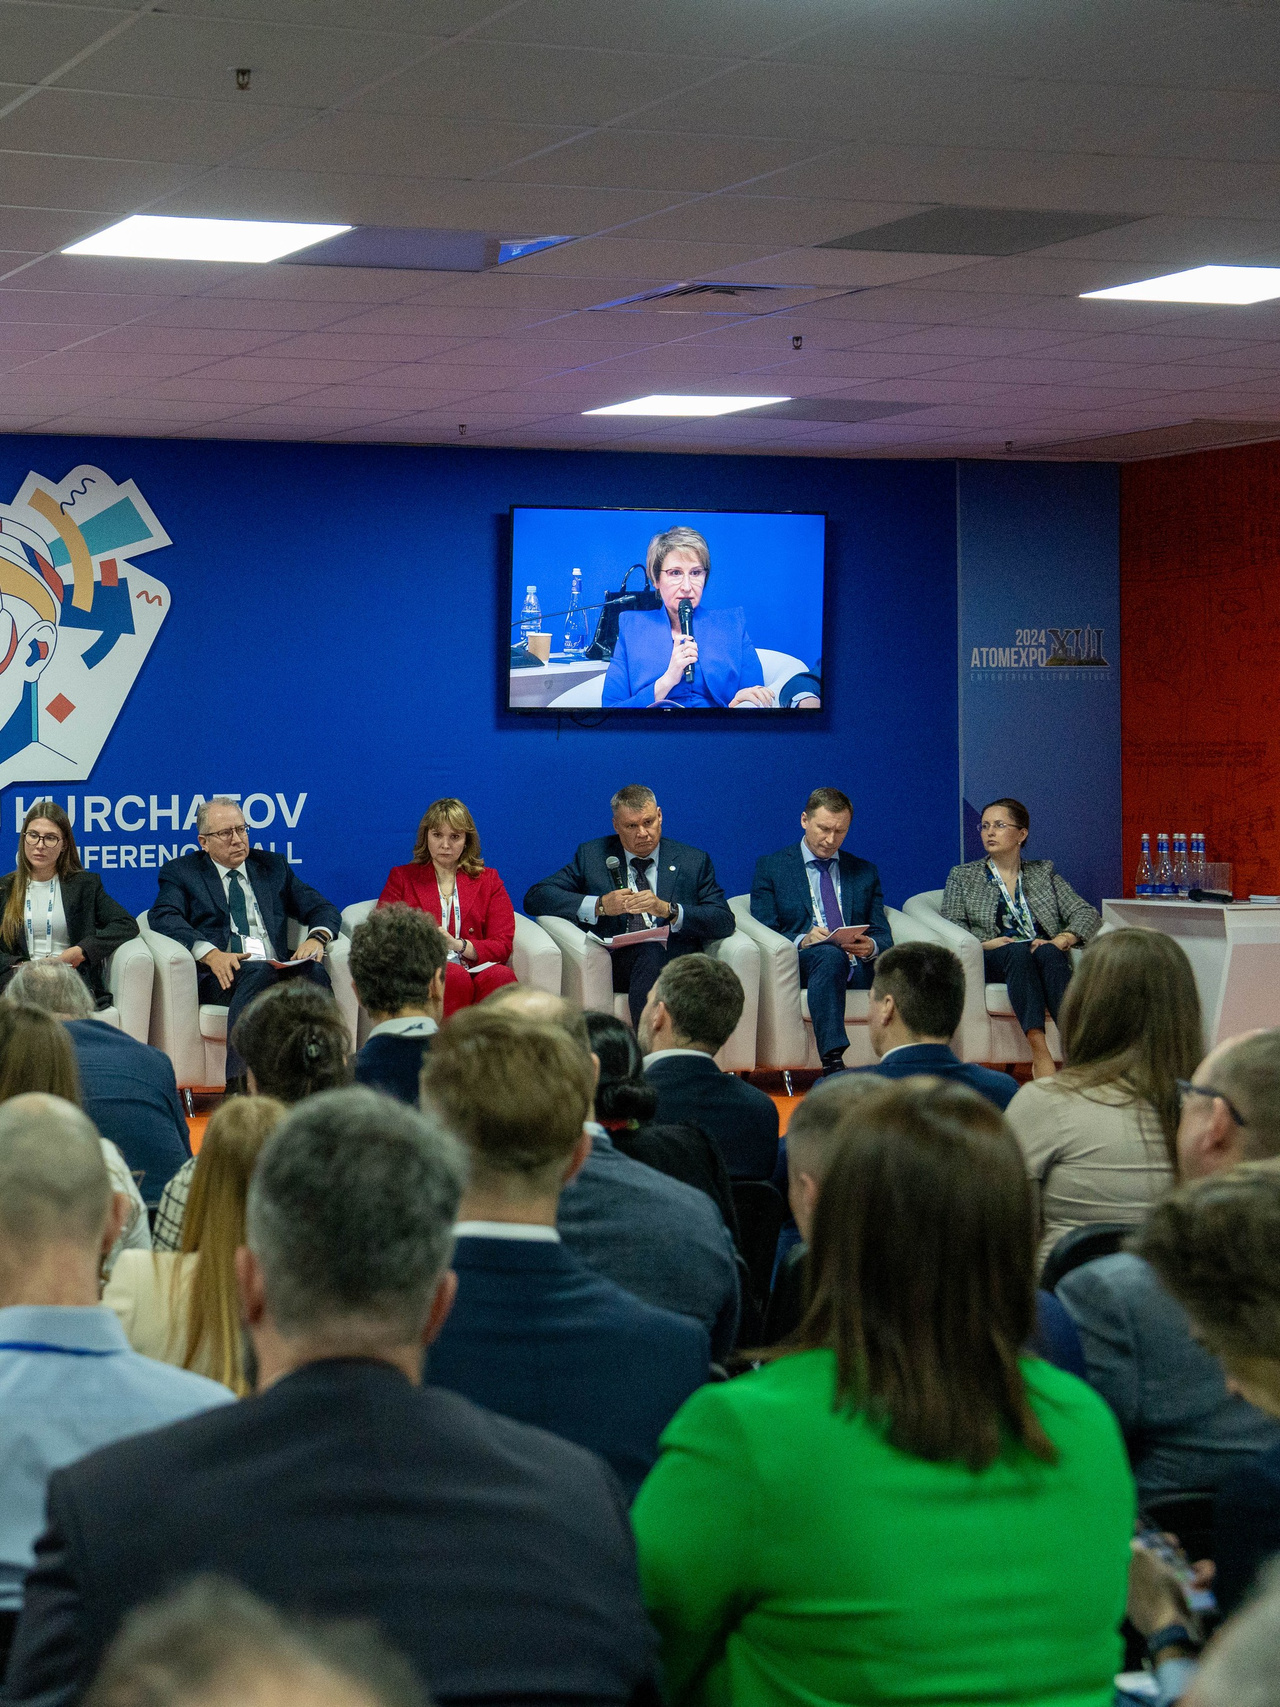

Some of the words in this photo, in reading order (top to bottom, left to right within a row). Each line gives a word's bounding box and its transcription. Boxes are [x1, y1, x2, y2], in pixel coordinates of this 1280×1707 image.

[1015, 629, 1047, 646] 2024
[970, 647, 1047, 668] ATOMEXPO
[15, 792, 308, 834] KRCHAOV
